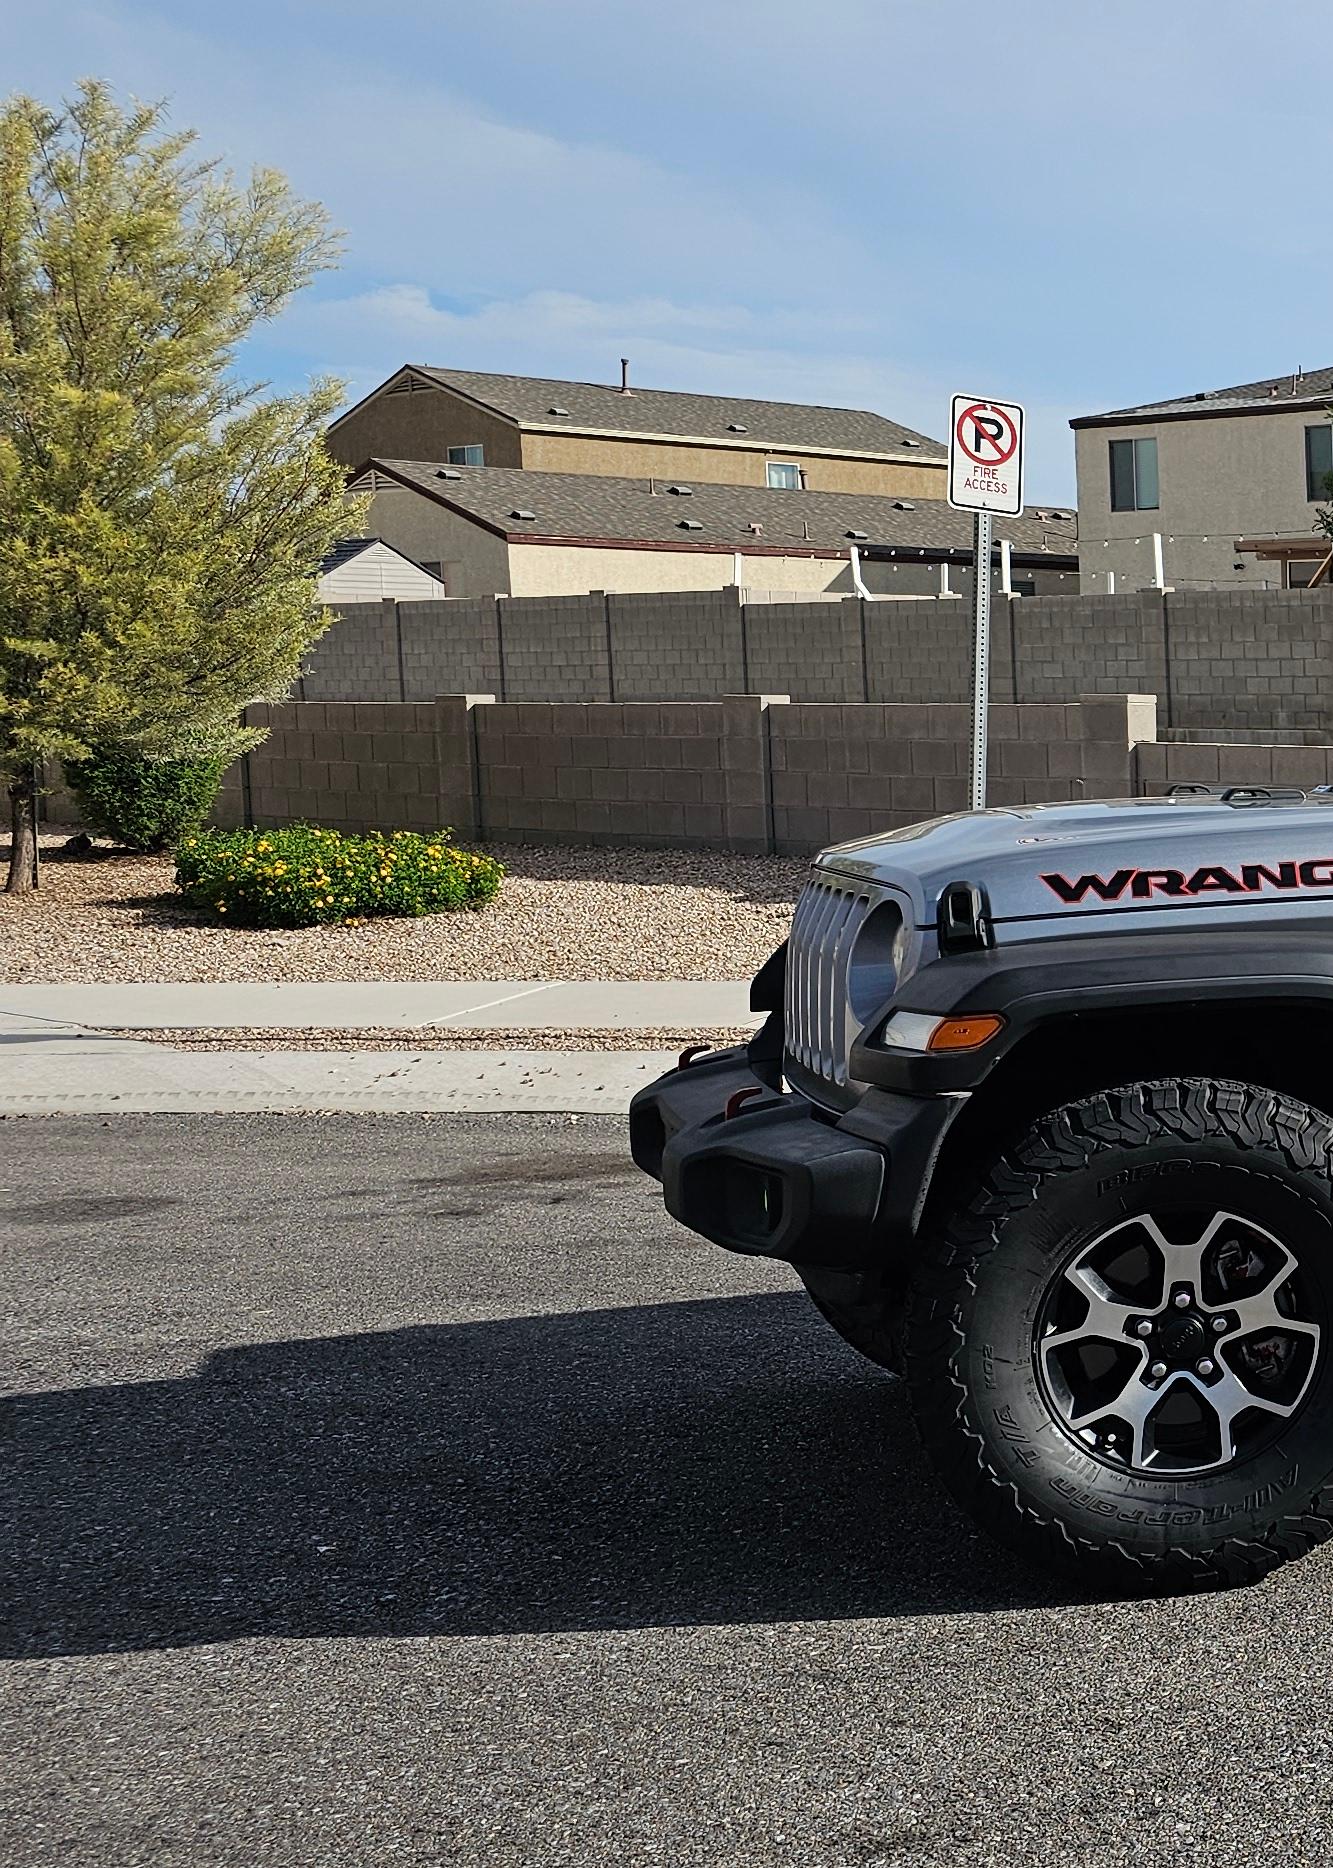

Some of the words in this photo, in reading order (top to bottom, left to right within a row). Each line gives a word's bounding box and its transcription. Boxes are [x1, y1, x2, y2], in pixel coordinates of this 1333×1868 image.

[974, 415, 1003, 452] P
[973, 466, 999, 480] FIRE
[963, 478, 1008, 494] ACCESS
